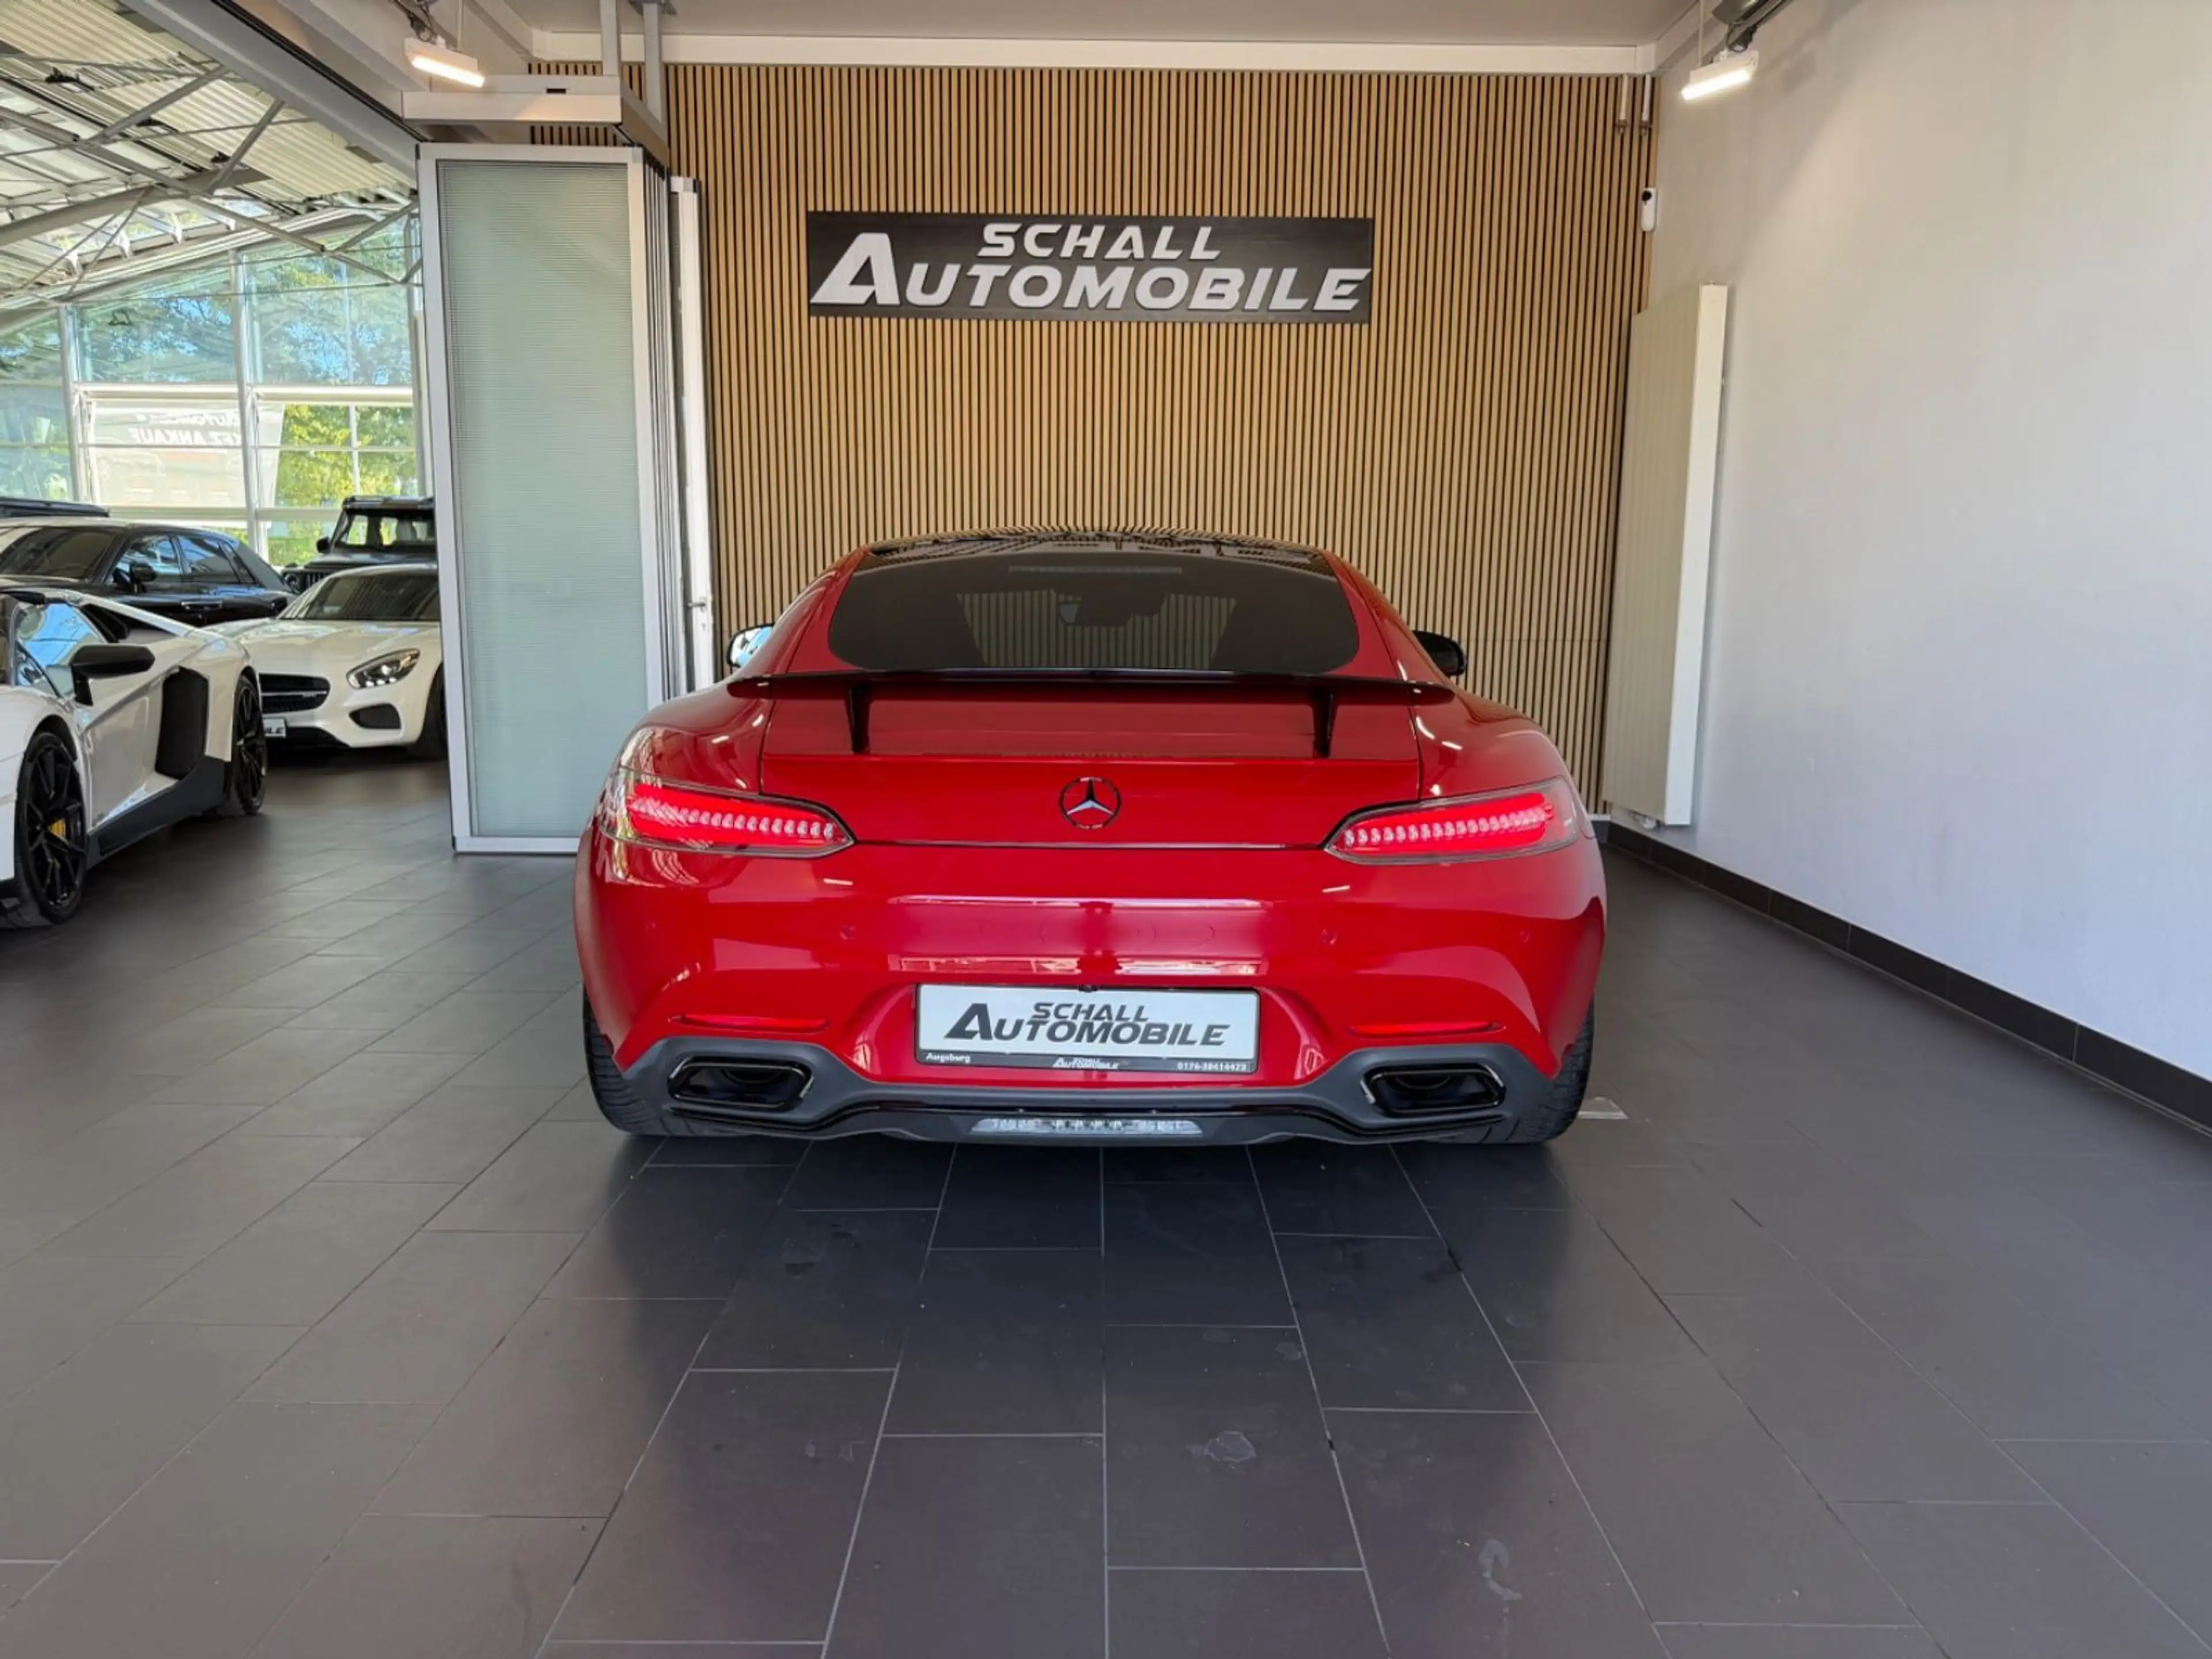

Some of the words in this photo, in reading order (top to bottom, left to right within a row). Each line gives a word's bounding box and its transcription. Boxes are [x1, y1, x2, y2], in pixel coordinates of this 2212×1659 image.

[978, 224, 1220, 259] SCHALL
[810, 233, 1370, 310] AUTOMOBILE
[945, 1003, 1230, 1046] AUTOMOBILE
[1032, 1002, 1148, 1022] SCHALL
[926, 1052, 971, 1065] Augsburg
